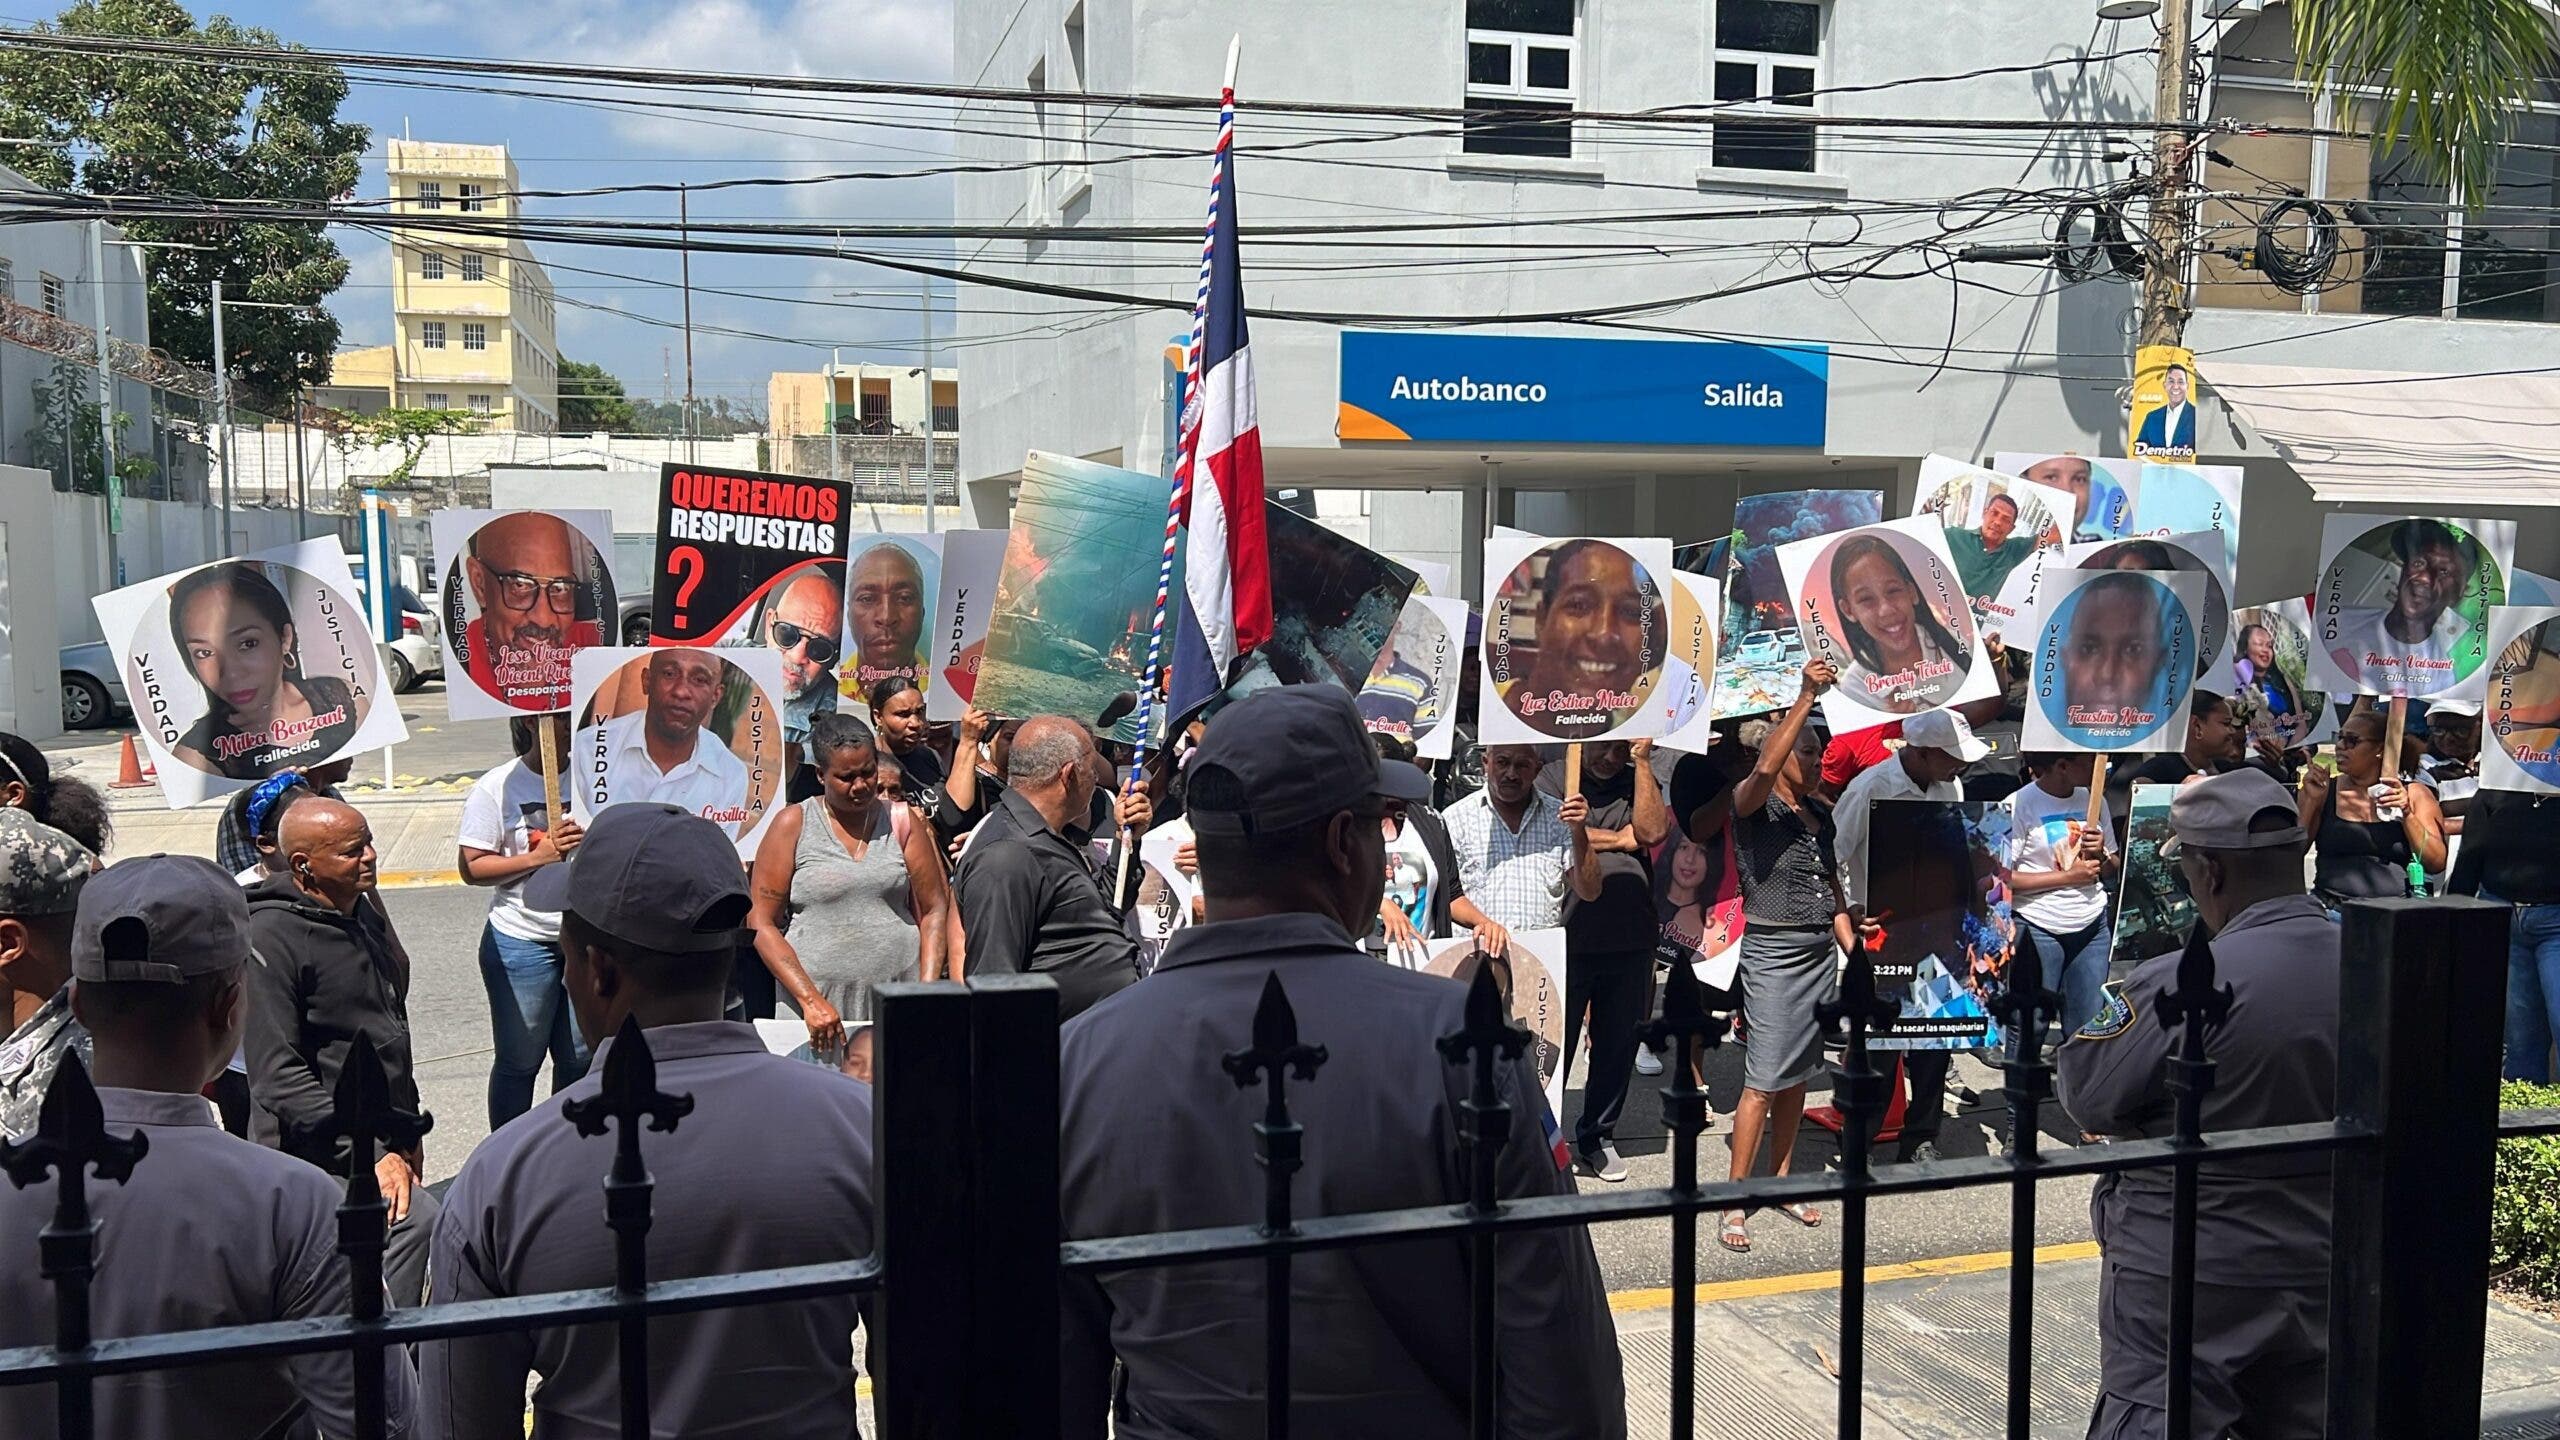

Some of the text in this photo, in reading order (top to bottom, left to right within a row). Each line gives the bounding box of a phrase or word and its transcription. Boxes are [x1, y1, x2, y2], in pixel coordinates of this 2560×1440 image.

[1390, 376, 1547, 402] Autobanco
[1704, 383, 1783, 408] Salida
[2133, 442, 2193, 458] Demetrio
[672, 472, 838, 522] QUEREMOS
[2112, 495, 2122, 540] JUST
[670, 508, 836, 555] RESPUESTAS
[2024, 518, 2050, 606] JUSTICIA
[451, 576, 470, 662] VERDAD
[591, 556, 605, 645] JUSTICI
[667, 545, 704, 629] ?
[1928, 557, 1968, 655] JUSTICIA
[1977, 594, 2017, 618] Cuevas
[2325, 567, 2344, 641] VERDAD
[2471, 562, 2491, 657] JUSTICIA
[316, 589, 367, 701] JUSTICIA
[499, 645, 530, 668] Jose
[949, 589, 968, 666] VERDAD
[1495, 600, 1511, 684] VERDAD
[1638, 582, 1652, 688] JUSTICIA
[2164, 613, 2183, 707] JUSTICIA
[495, 664, 544, 686] Dicent
[1426, 634, 1445, 717] JUSTICIA
[1687, 615, 1702, 706] JUSTICIA
[1894, 683, 1940, 703] Fallecida
[2041, 624, 2060, 698] VERDAD
[2378, 672, 2432, 684] Fallecido
[135, 652, 179, 746] VERDAD
[1520, 692, 1547, 716] Luz
[1547, 690, 1595, 713] Esther
[1555, 712, 1606, 726] Fallecida
[2499, 661, 2514, 736] VERDAD
[213, 704, 347, 760] Milka Benzant
[254, 739, 321, 767] Fallecida
[594, 714, 608, 804] VERDAD
[751, 696, 763, 811] JUSTICIA
[2087, 727, 2131, 738] Fallecido
[2513, 745, 2551, 763] Ana
[701, 804, 749, 824] Casilla
[1873, 965, 1912, 976] 3:22 PM
[1536, 977, 1547, 1082] JUSTICIA
[1891, 1023, 1902, 1033] de
[1903, 1024, 1925, 1033] sacar
[1926, 1023, 1938, 1032] las
[1939, 1022, 1985, 1035] maquinarias
